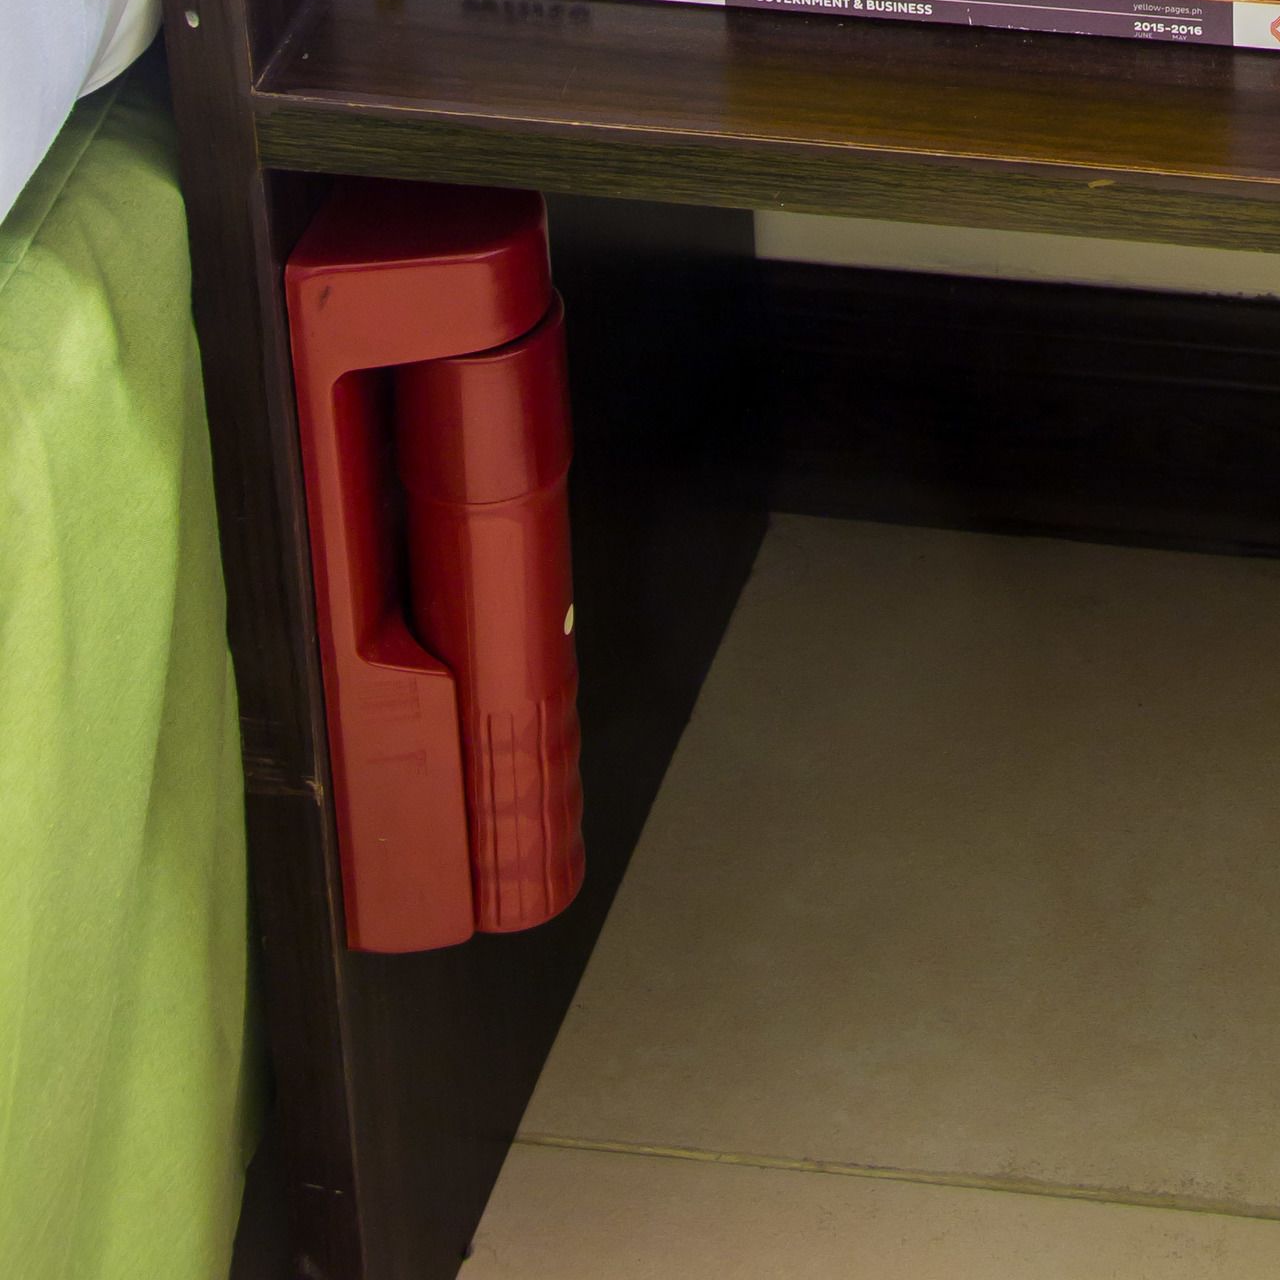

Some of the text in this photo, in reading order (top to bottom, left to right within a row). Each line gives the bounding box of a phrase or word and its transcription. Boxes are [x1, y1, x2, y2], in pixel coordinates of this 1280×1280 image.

[866, 0, 933, 15] BUSINESS
[1132, 2, 1203, 16] yellow-pages.ph
[1133, 21, 1203, 36] 2015-2016
